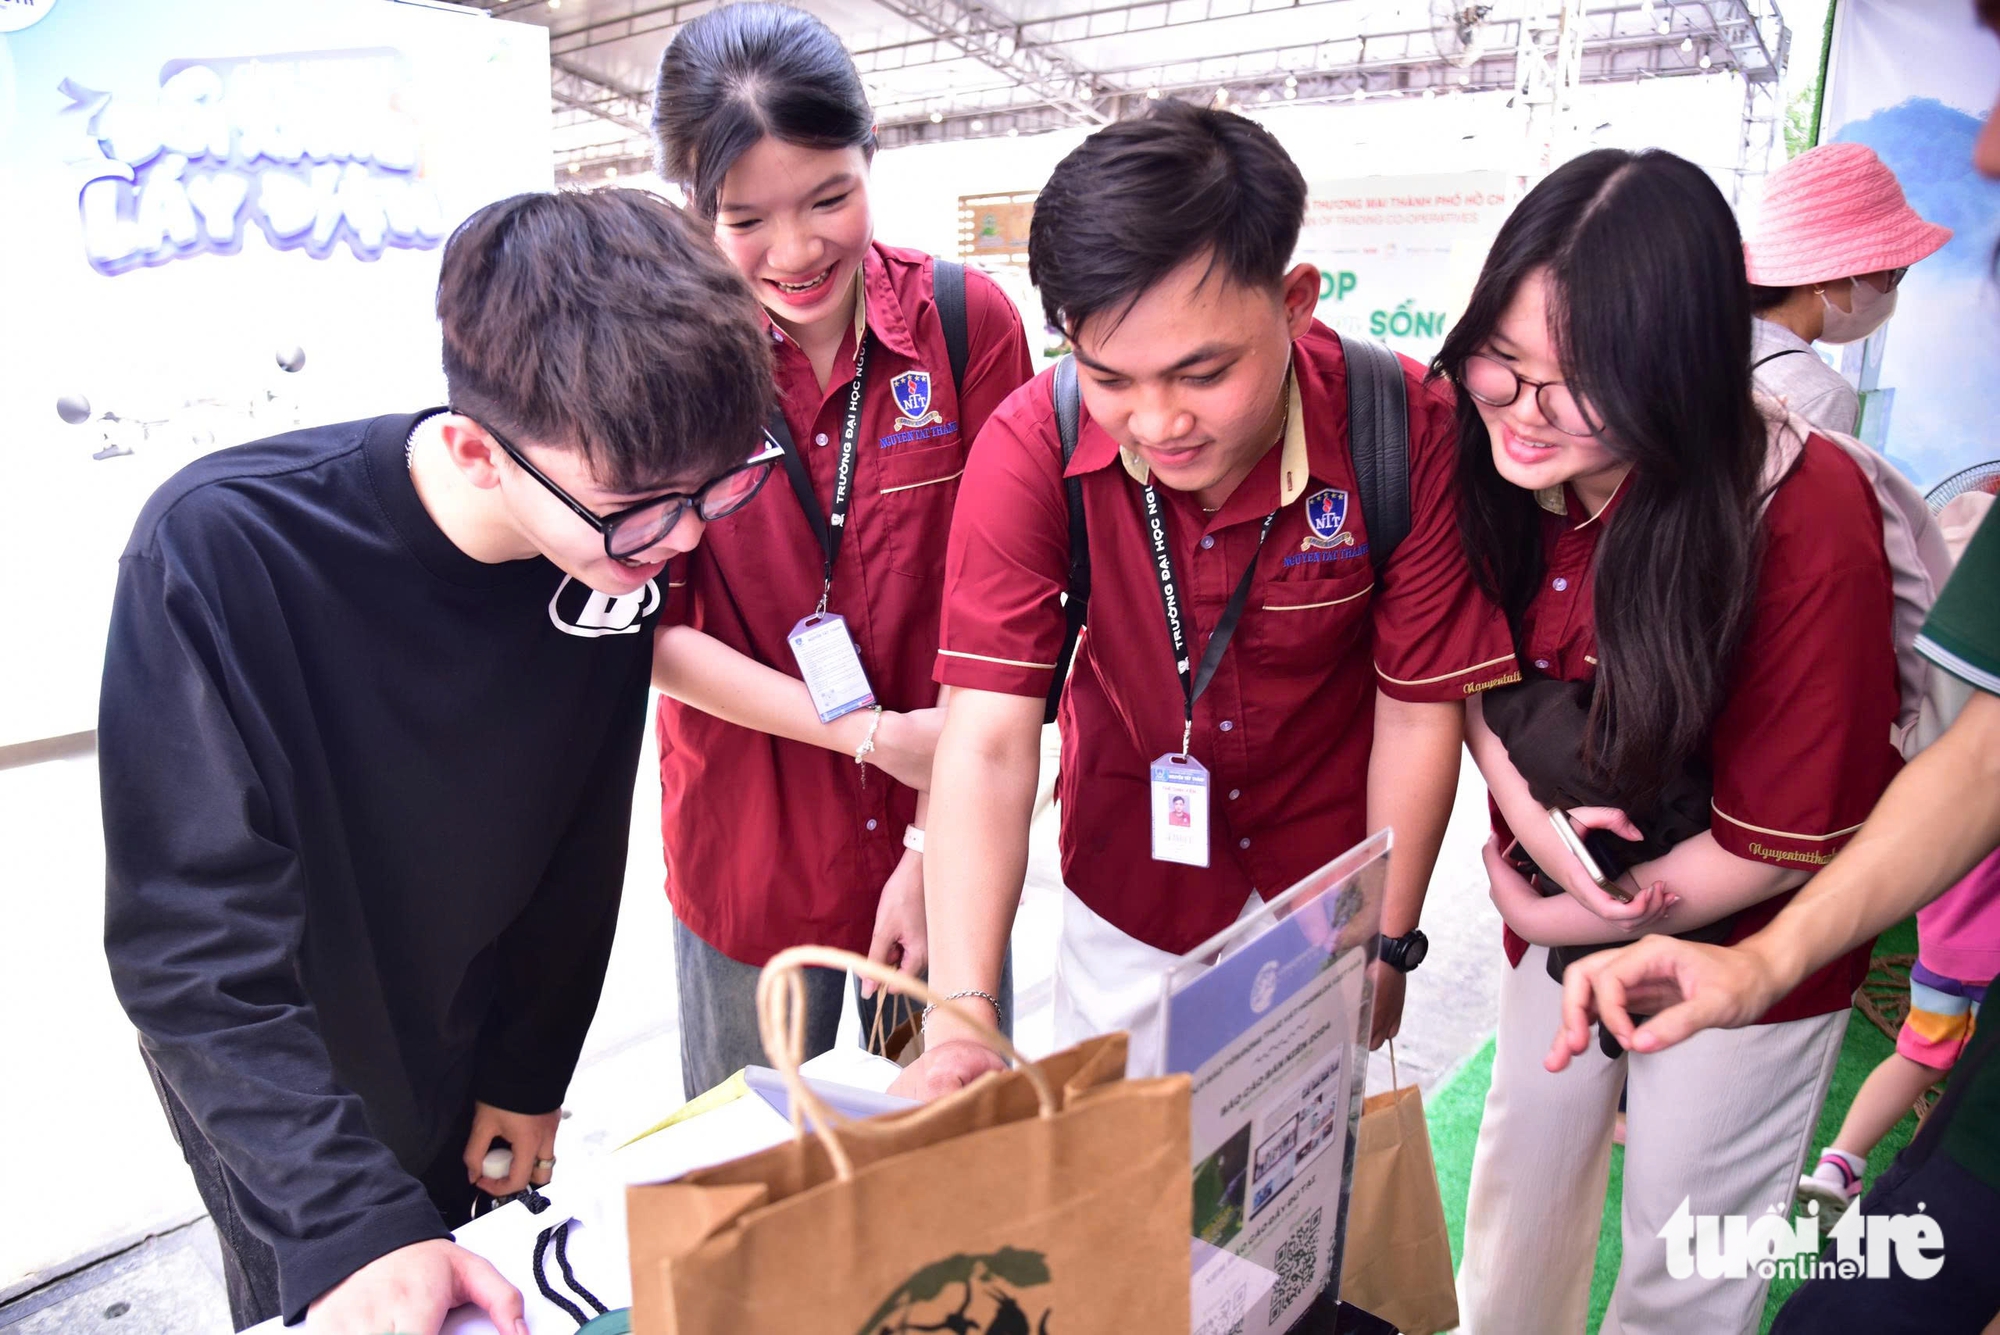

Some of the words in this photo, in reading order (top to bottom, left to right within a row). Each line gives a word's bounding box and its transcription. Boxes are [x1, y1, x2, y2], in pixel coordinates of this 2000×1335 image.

[849, 380, 861, 411] HỌC
[844, 414, 858, 440] ĐẠI
[836, 440, 852, 504] TRƯỜNG
[1150, 518, 1166, 552] HỌC
[1158, 554, 1171, 582] ĐẠI
[1163, 581, 1184, 651] TRƯỜNG
